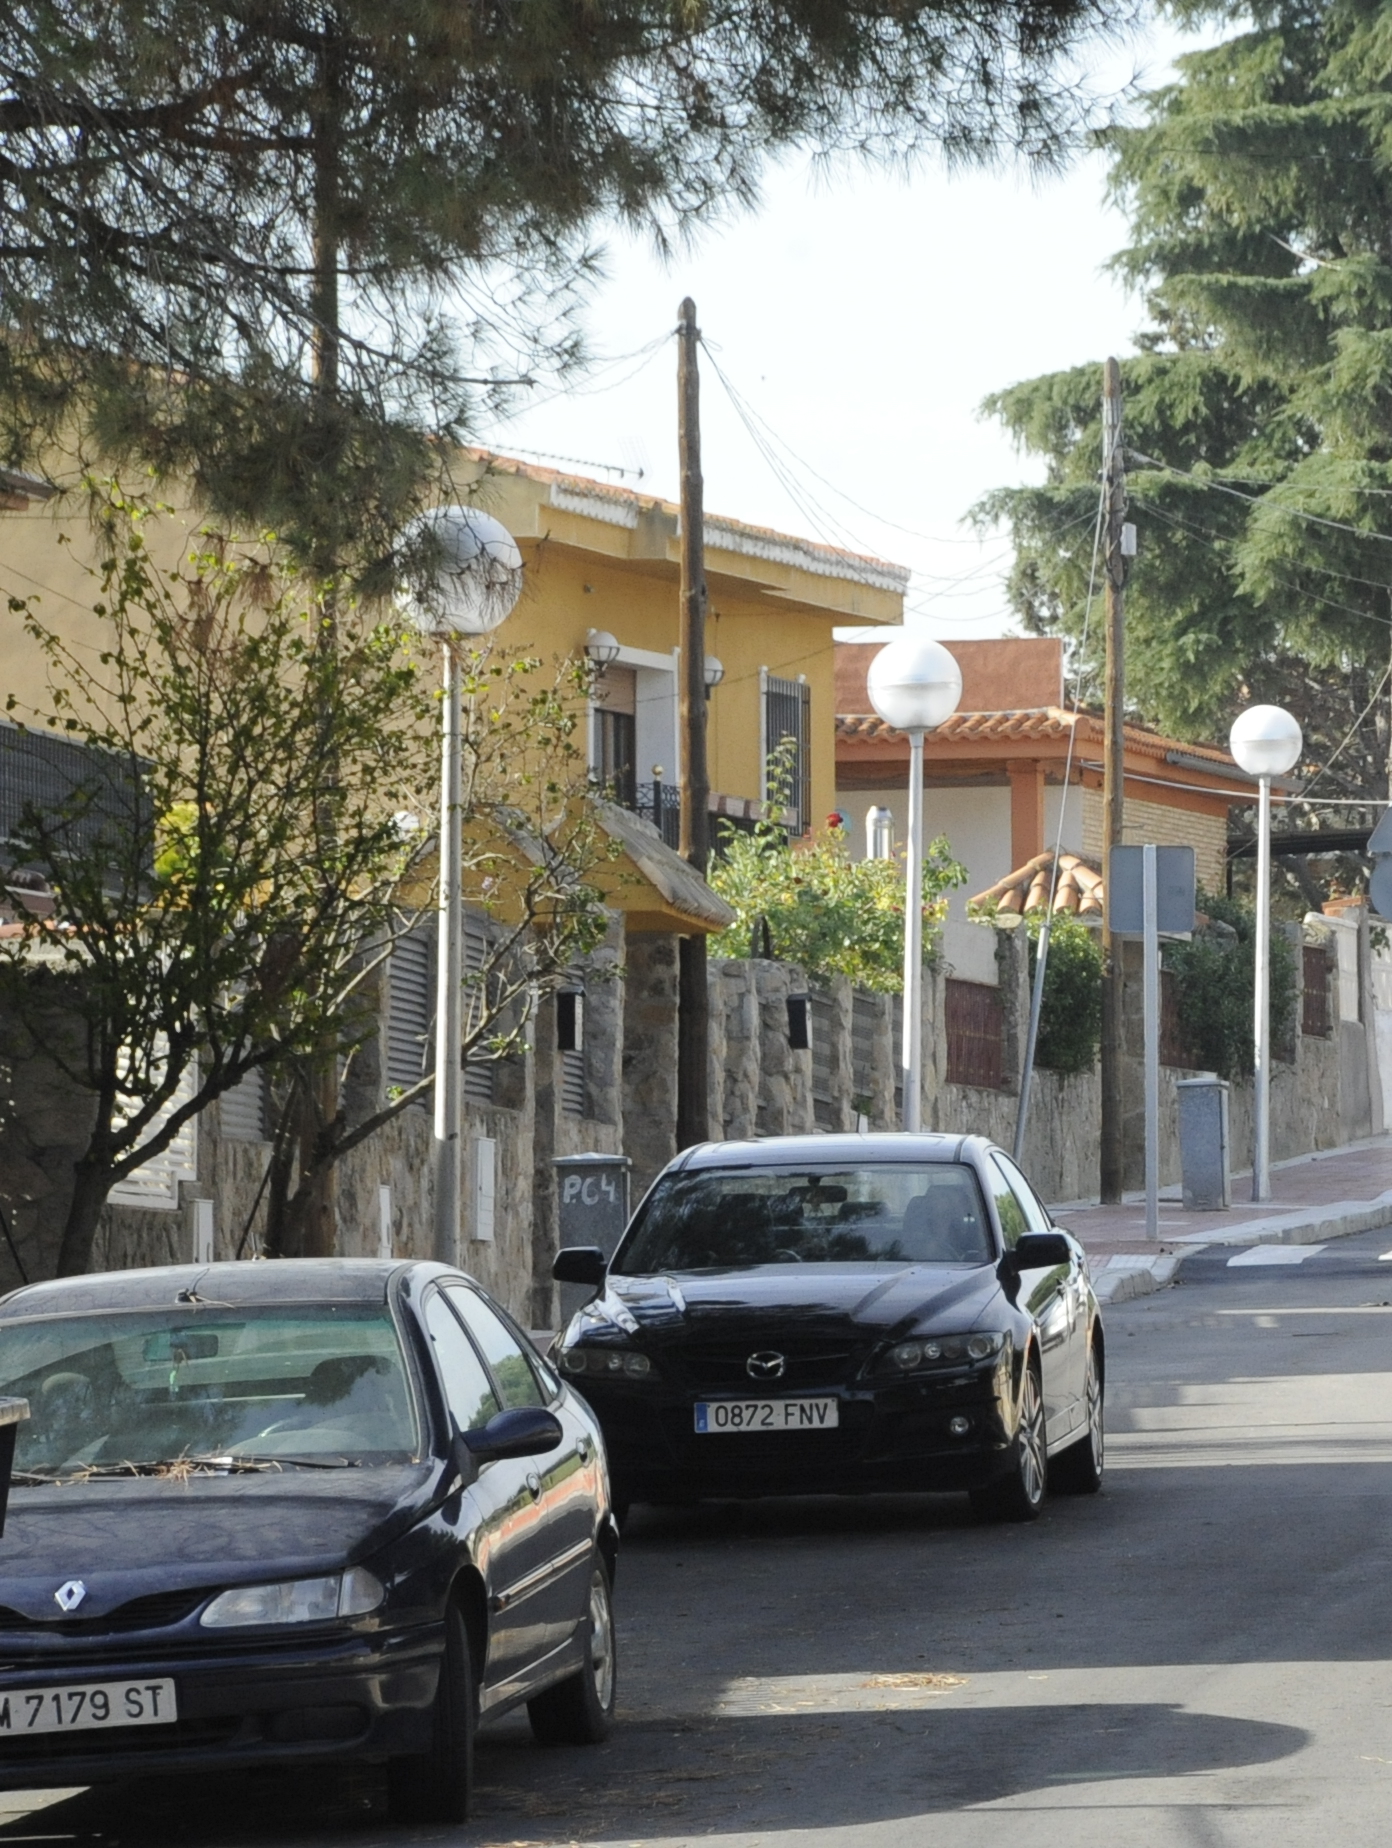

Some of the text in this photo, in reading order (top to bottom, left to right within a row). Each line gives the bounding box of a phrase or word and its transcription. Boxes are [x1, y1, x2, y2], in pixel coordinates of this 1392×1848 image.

[715, 1402, 828, 1427] 0872 FNV
[25, 1690, 110, 1727] 7179
[124, 1685, 163, 1718] ST
